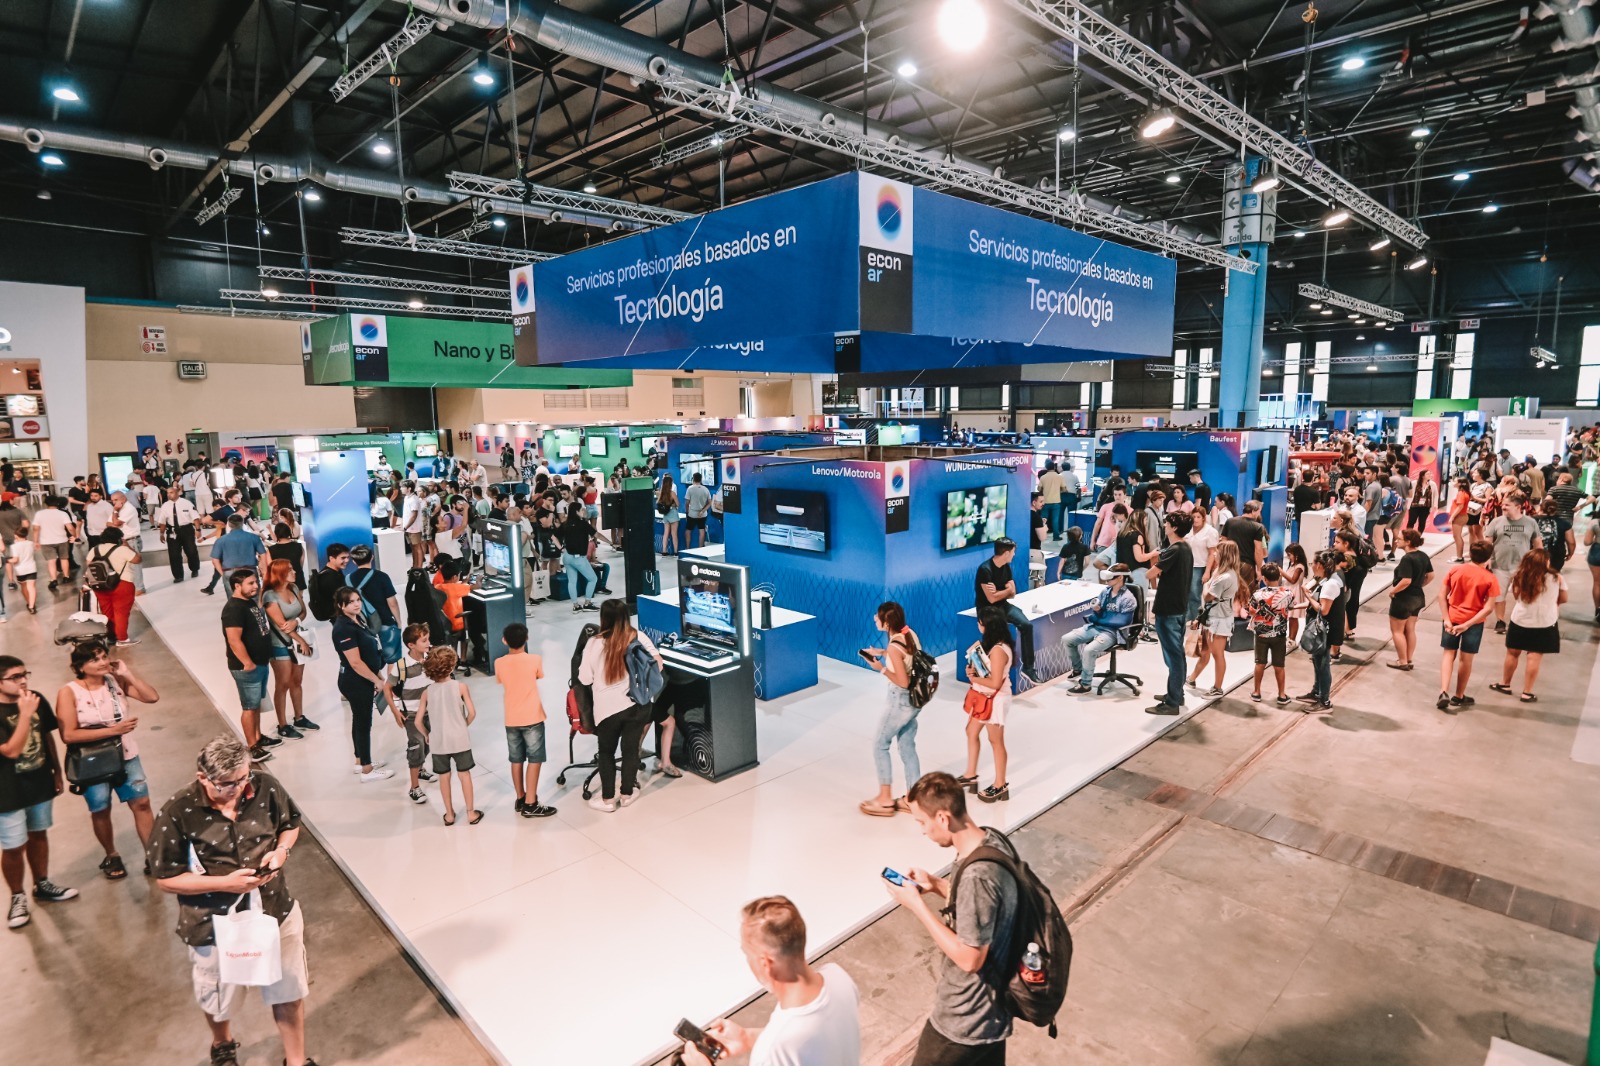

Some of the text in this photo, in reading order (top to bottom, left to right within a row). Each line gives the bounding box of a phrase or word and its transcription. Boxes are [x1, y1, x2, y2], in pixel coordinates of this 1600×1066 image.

[1229, 233, 1252, 243] Salda
[567, 225, 797, 294] Servicios profesionales basados en
[867, 252, 902, 271] econ
[969, 229, 1153, 290] Servicios profesionales basados en
[867, 268, 883, 282] ar
[614, 277, 724, 325] Tecnología
[1026, 277, 1113, 328] Tecnología
[513, 315, 531, 326] econ
[514, 327, 522, 336] ar
[835, 337, 855, 345] econ
[355, 347, 380, 355] econ
[434, 340, 481, 359] Nano
[485, 347, 495, 363] y
[909, 388, 917, 400] 7
[1209, 435, 1238, 443] Baufest
[993, 456, 1029, 467] THOMPSON
[812, 465, 882, 480] Lenovo/Motorola
[887, 499, 904, 507] econ
